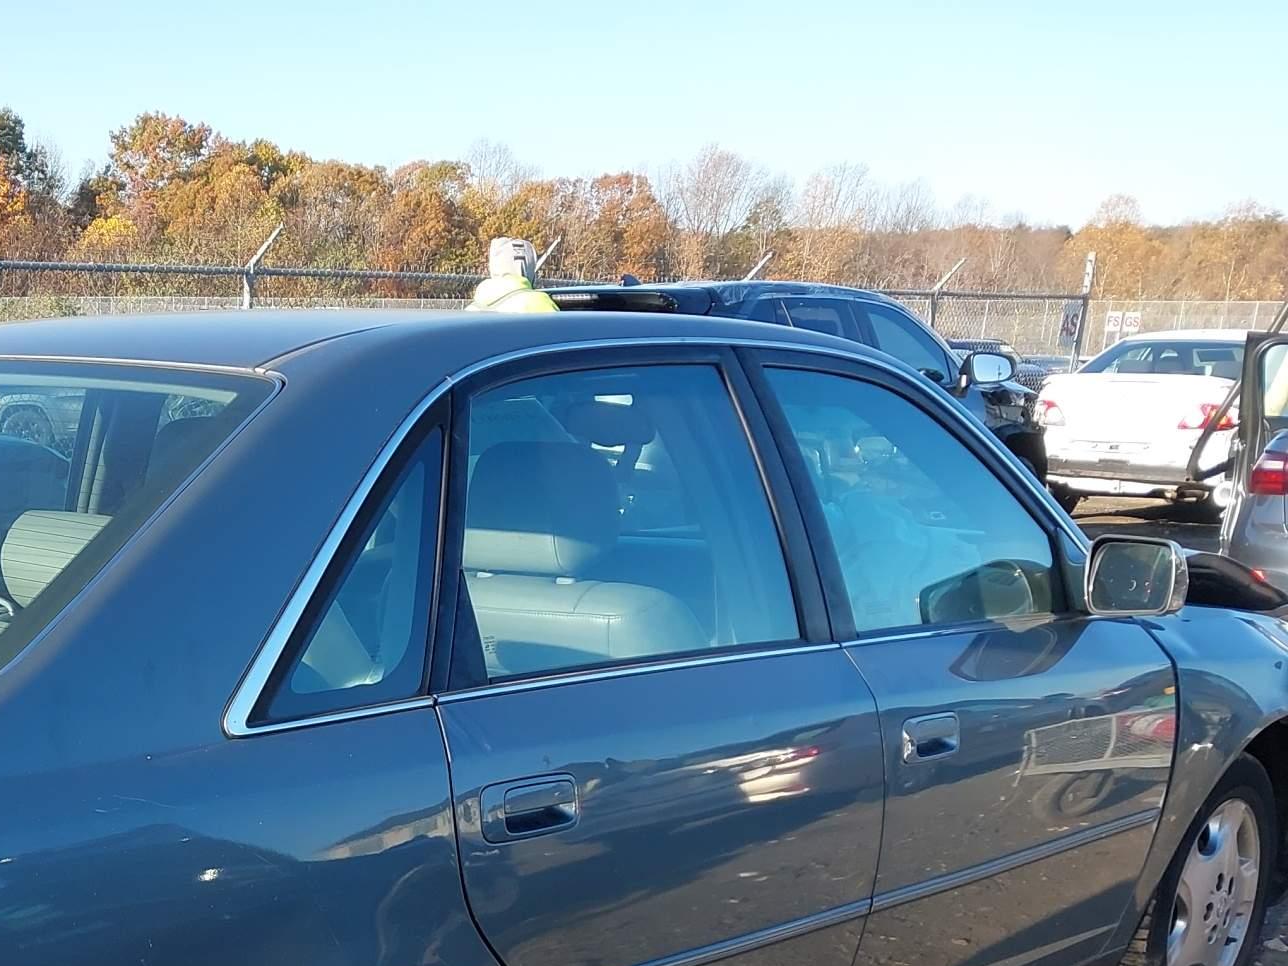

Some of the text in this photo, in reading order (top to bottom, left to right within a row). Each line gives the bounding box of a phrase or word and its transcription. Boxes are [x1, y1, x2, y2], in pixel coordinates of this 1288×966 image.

[1060, 313, 1078, 336] AS
[1107, 315, 1120, 328] FS
[1125, 315, 1139, 328] GS
